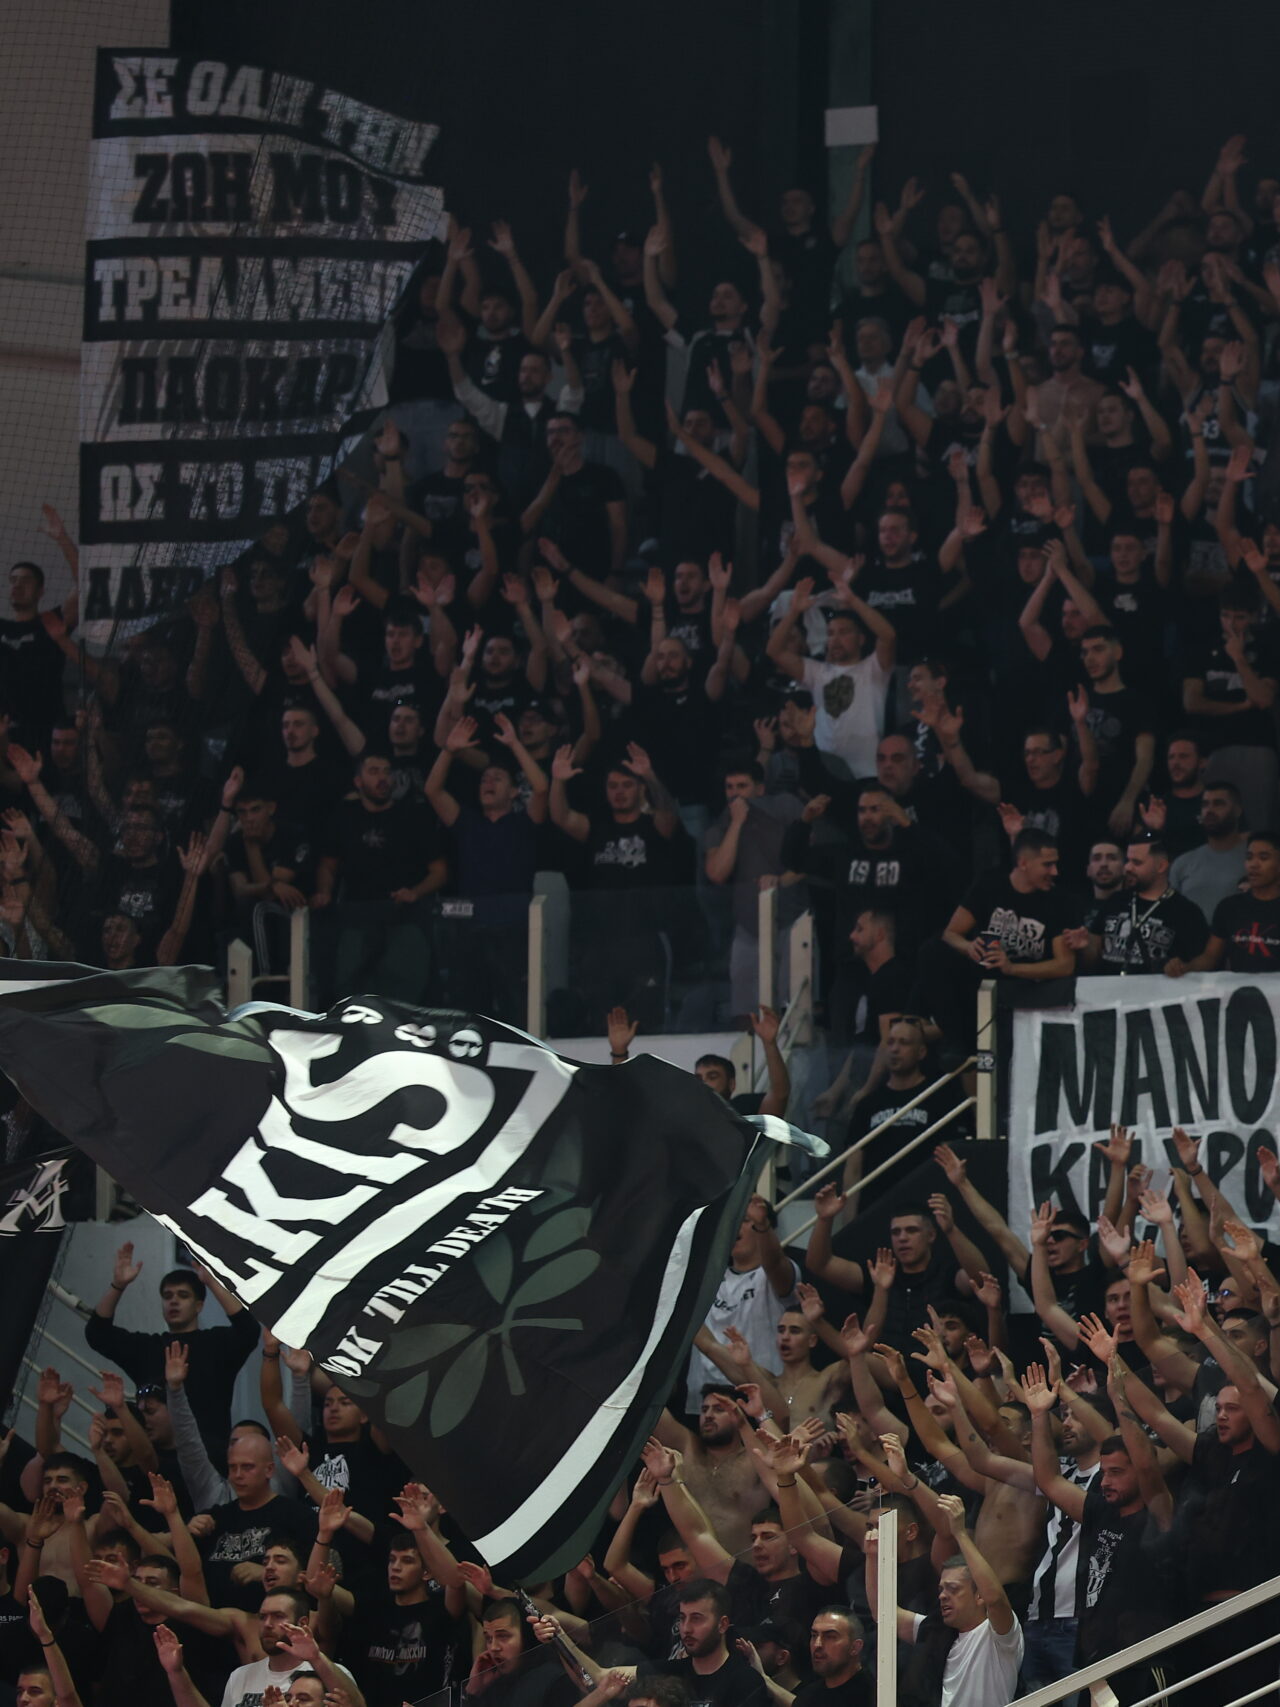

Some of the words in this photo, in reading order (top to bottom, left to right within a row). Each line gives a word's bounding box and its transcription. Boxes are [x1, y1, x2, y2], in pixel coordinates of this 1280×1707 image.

[110, 56, 180, 119] ΣΕ
[186, 60, 314, 128] ΟΛΗ
[133, 153, 254, 223] ΖΩΗ
[262, 152, 402, 226] ΜΟΥ
[99, 462, 166, 523] ΩΣ
[178, 460, 244, 521] ΤΟ
[1034, 985, 1277, 1135] ΜΑΝΟ
[362, 1262, 451, 1325] TILL
[425, 1185, 545, 1259] DEATH
